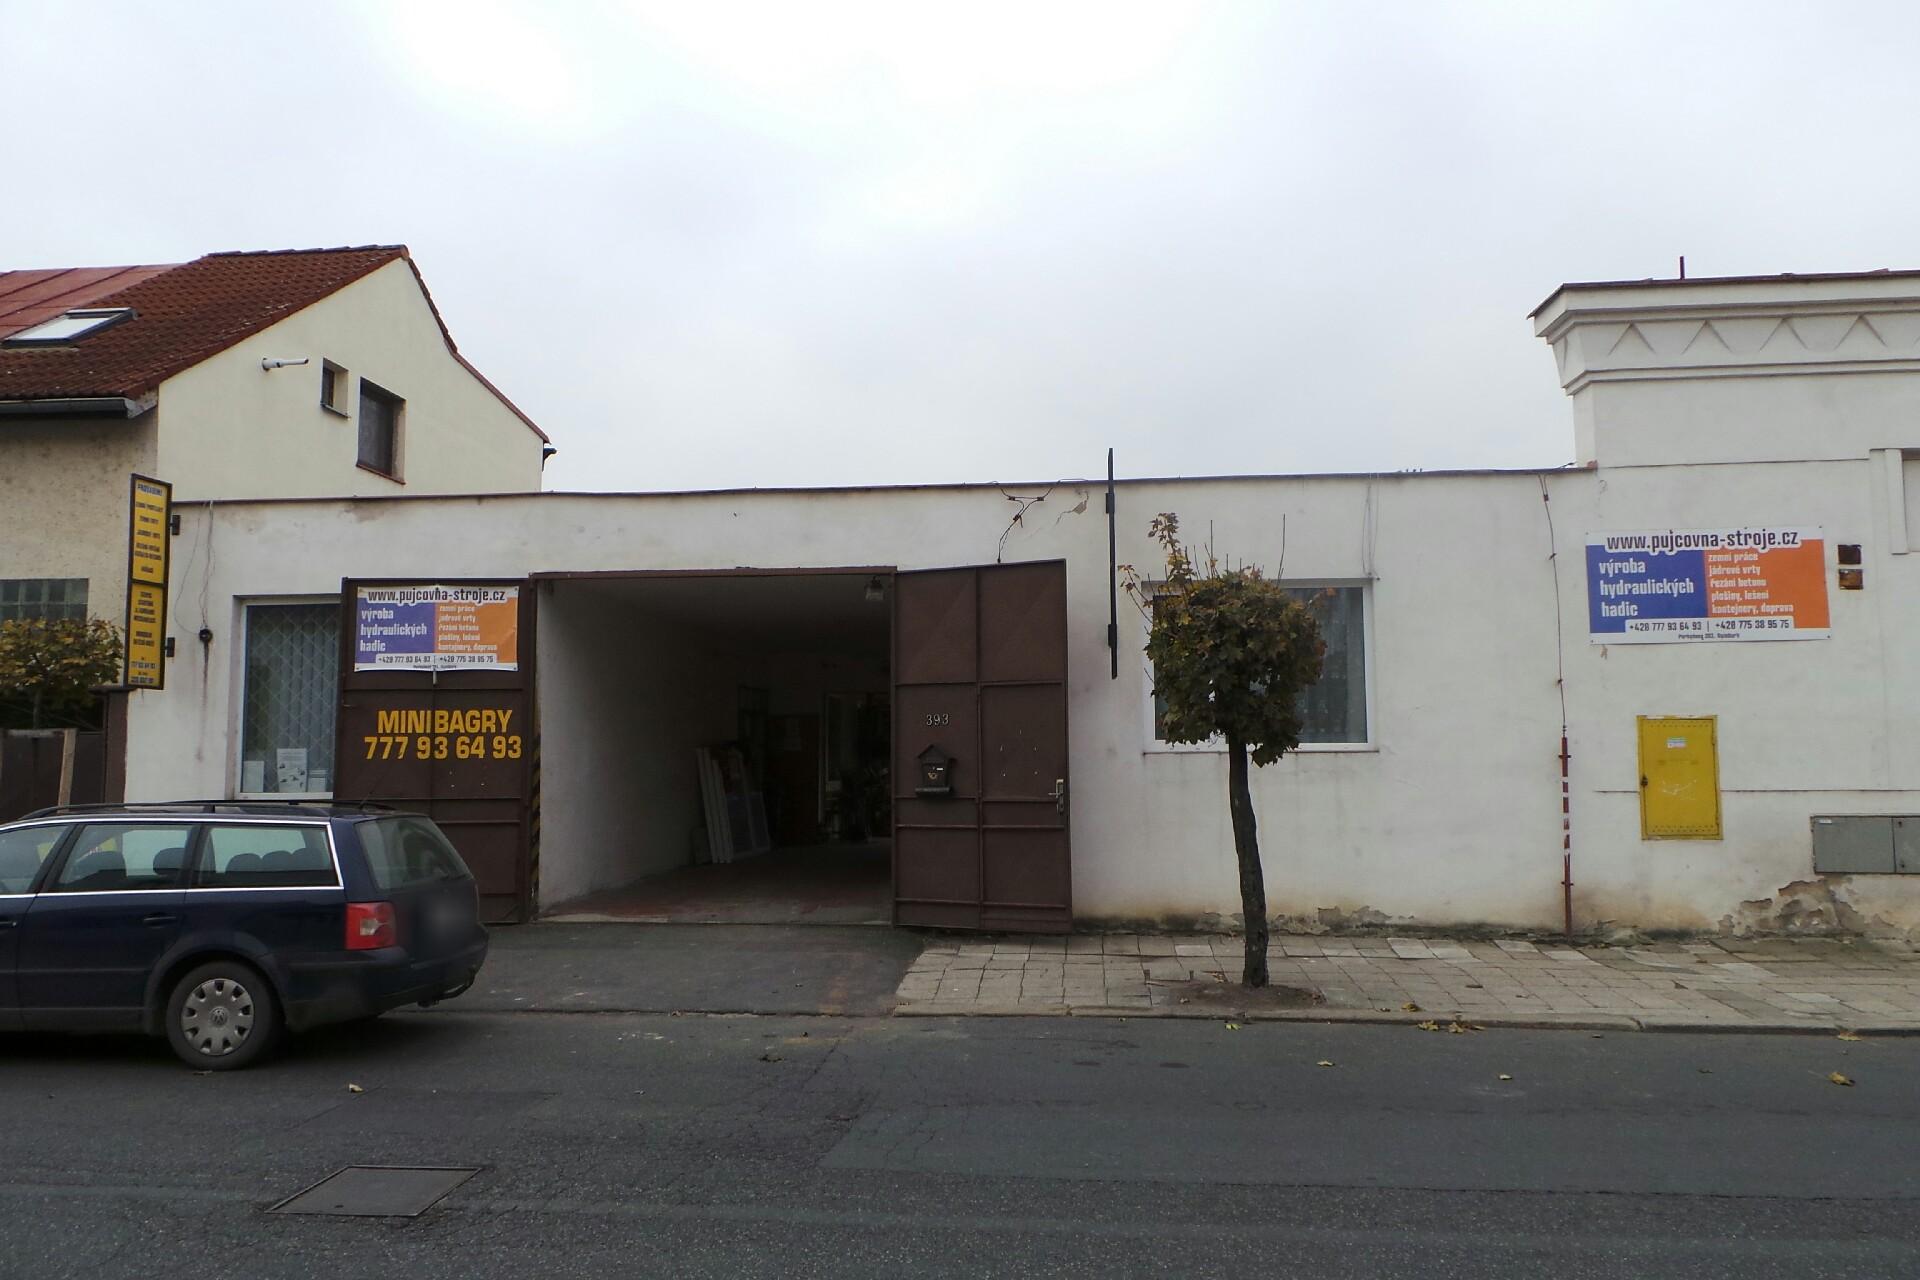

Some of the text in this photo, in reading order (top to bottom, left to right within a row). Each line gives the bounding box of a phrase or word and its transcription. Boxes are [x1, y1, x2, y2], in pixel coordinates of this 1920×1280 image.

[1607, 530, 1798, 552] www.pujcovna-stroje.cz
[1599, 558, 1646, 577] výroba
[367, 587, 505, 604] www.pujcovna-stroje.cz
[1600, 578, 1694, 599] hydraulických
[361, 607, 394, 622] výroba
[1601, 601, 1638, 617] hadic
[360, 622, 427, 638] hydraulických
[1652, 622, 1665, 632] 777
[1667, 622, 1677, 631] 93
[1679, 621, 1690, 631] 64
[1692, 621, 1702, 630] 93
[1739, 620, 1753, 629] 775
[1767, 619, 1778, 629] 95
[1779, 619, 1790, 629] 75
[360, 639, 386, 652] hadic
[926, 713, 950, 726] 393
[364, 735, 522, 760] 777 93 64 93
